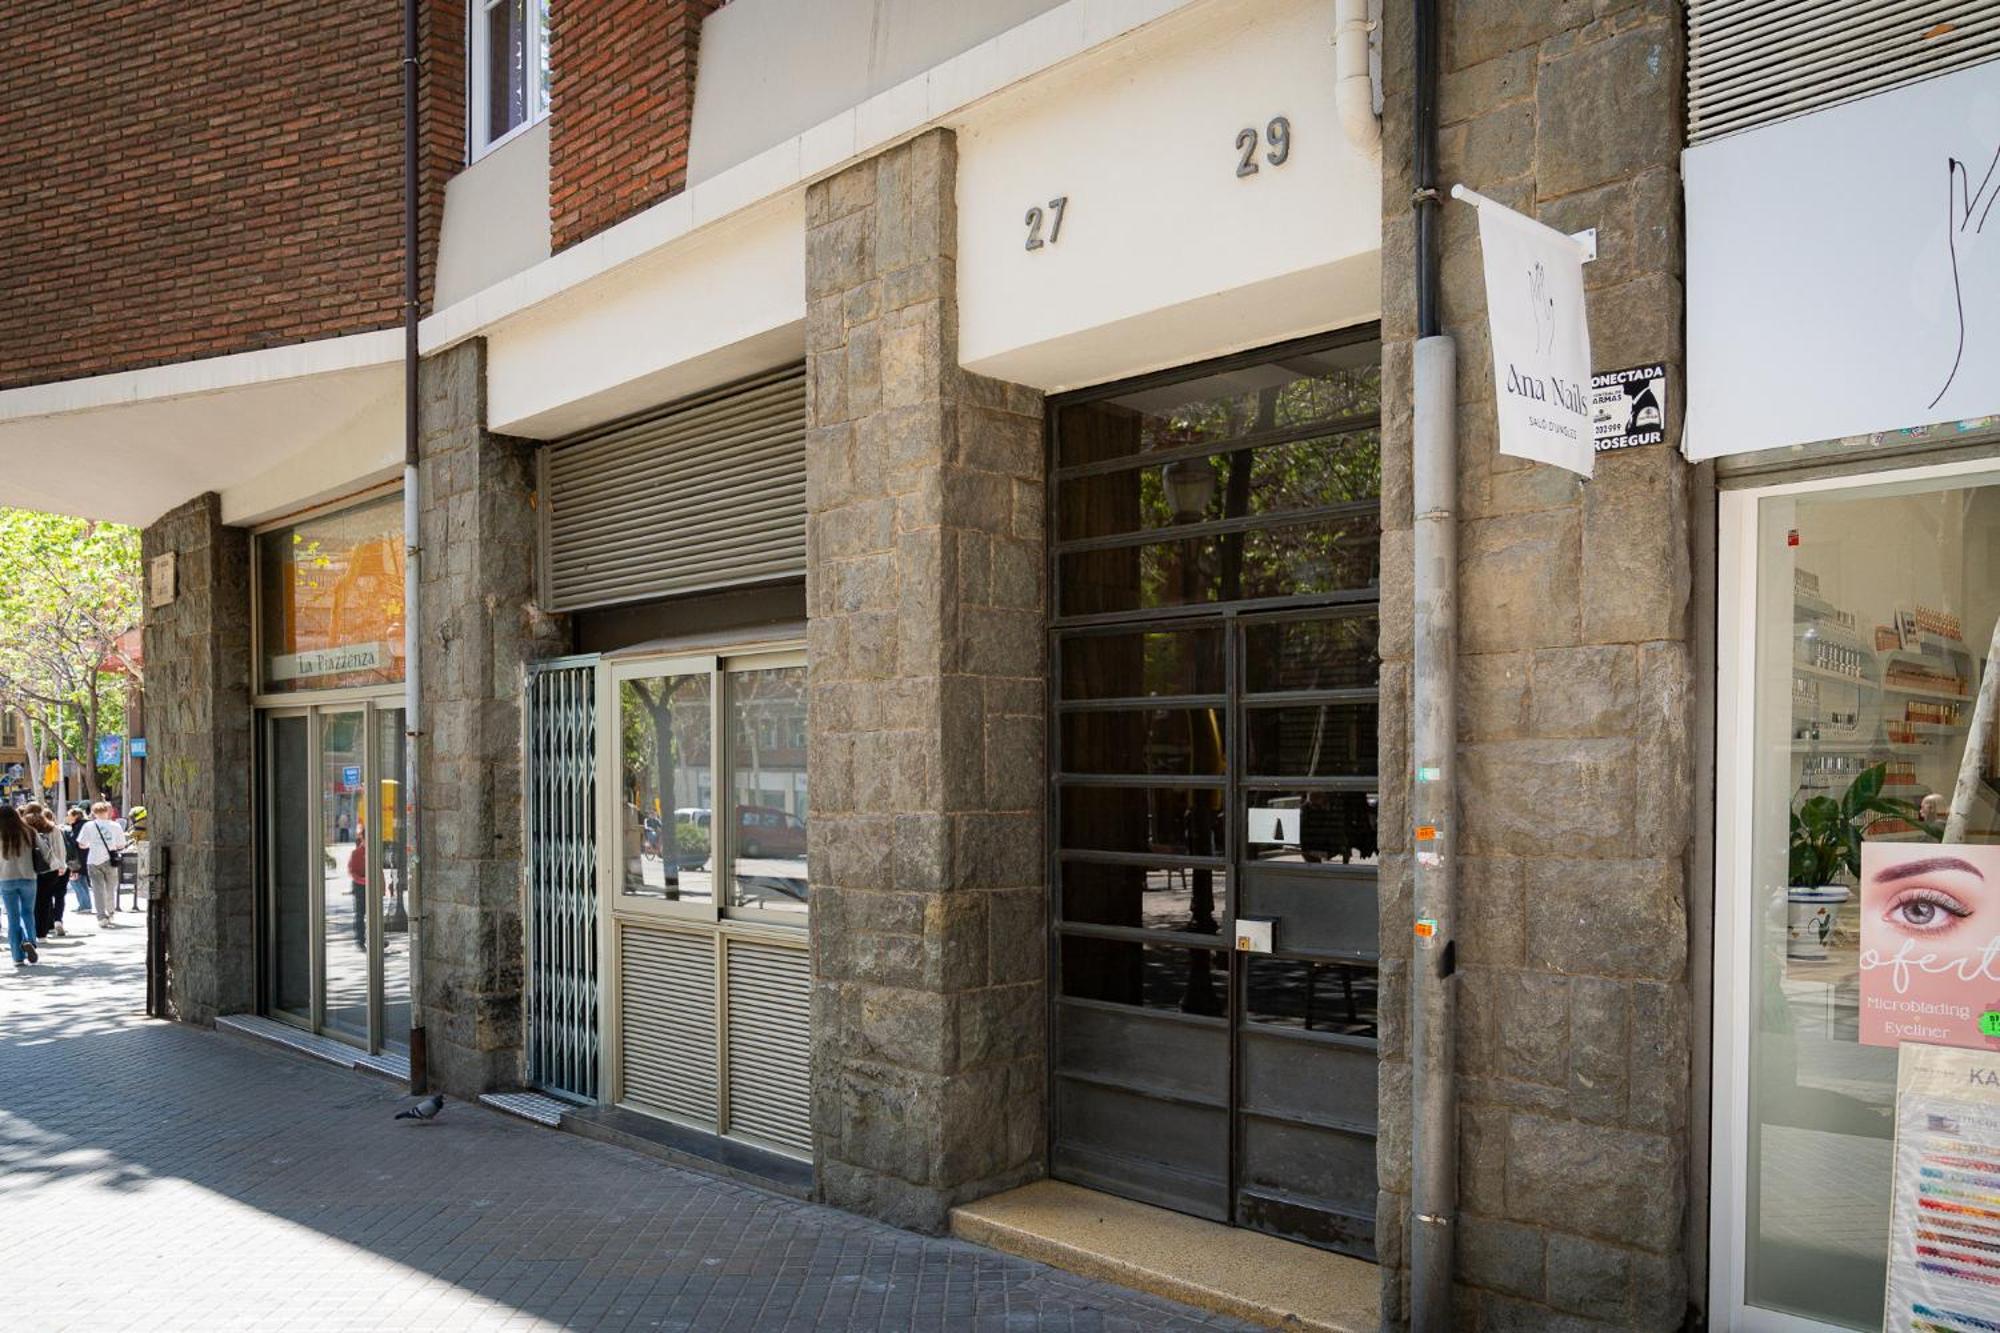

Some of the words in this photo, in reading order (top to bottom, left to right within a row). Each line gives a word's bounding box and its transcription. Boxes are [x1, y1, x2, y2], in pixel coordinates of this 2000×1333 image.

[1235, 116, 1290, 178] 29
[1024, 196, 1068, 251] 27
[1592, 366, 1663, 387] ONECTADA
[1507, 363, 1546, 402] Ana
[1552, 376, 1588, 416] Nails
[1593, 394, 1622, 405] ARMAS
[1595, 432, 1661, 452] ROSEGUR
[299, 655, 313, 674] La
[1859, 935, 2000, 994] ofert
[1866, 997, 1971, 1020] Microblading
[1884, 1021, 1951, 1039] Eyeliner
